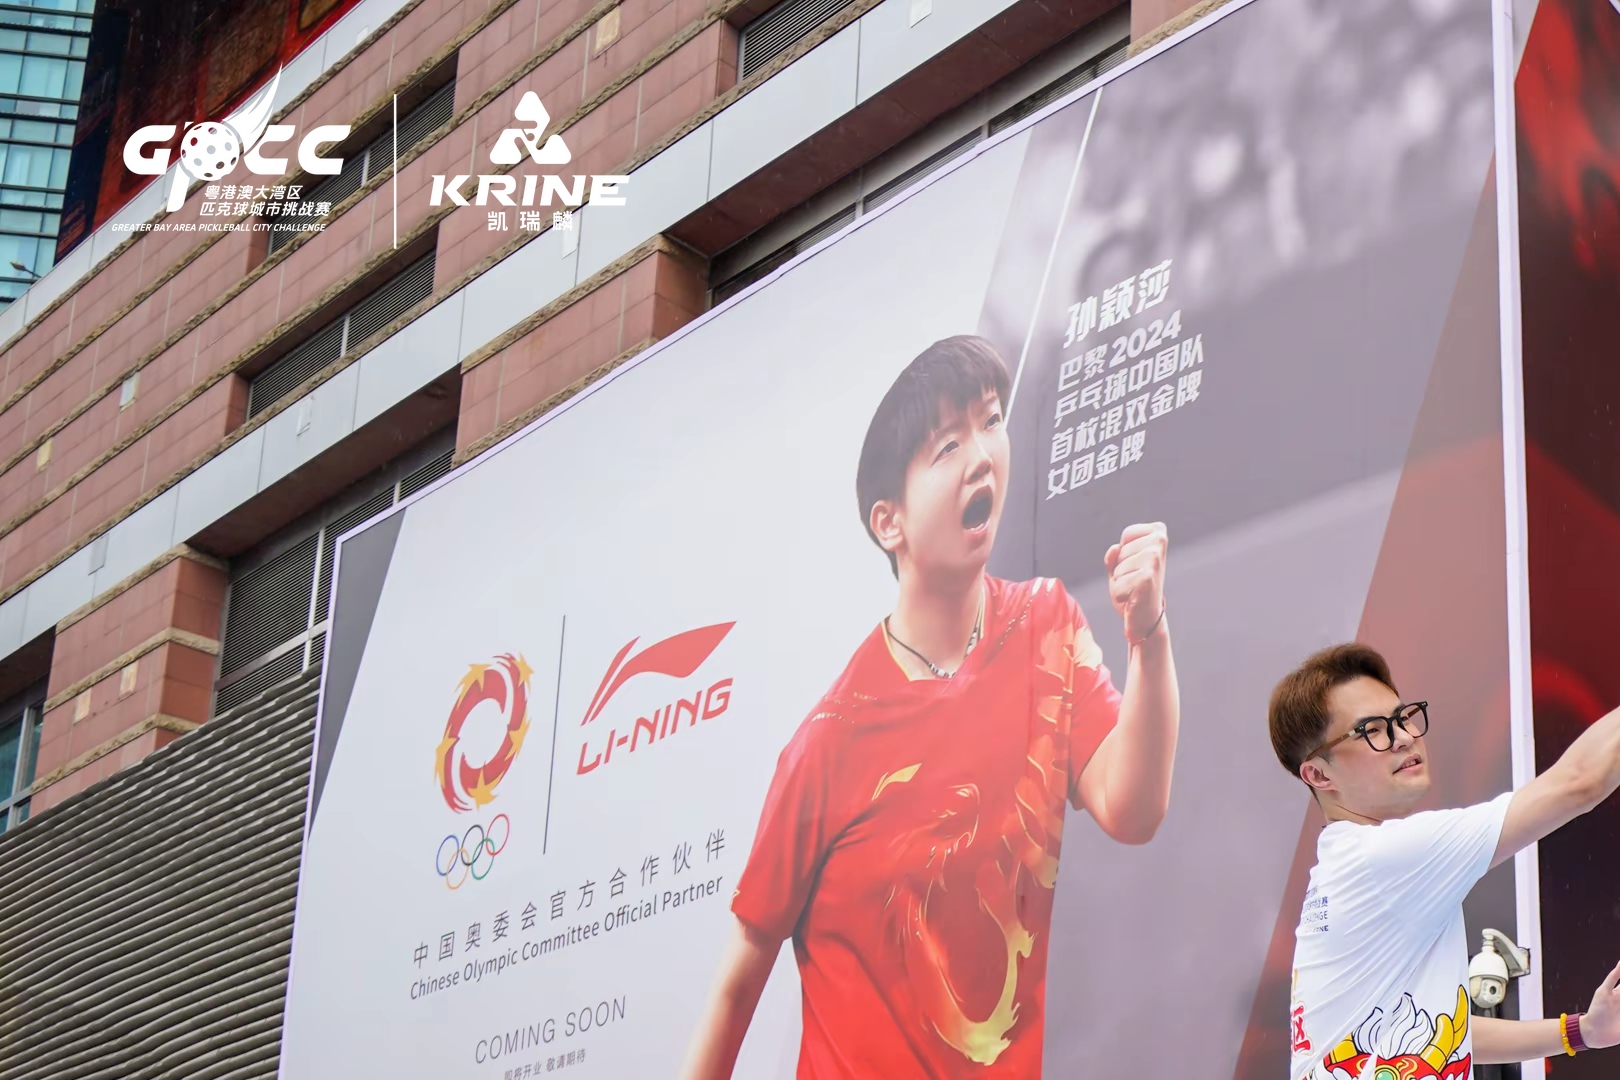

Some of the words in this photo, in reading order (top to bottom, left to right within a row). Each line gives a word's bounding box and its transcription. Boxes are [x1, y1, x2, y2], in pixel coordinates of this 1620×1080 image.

[1063, 259, 1173, 349] 孙颖莎
[1050, 369, 1203, 464] 首枚混双金牌
[1054, 333, 1204, 428] 乒乓球中国队
[1045, 430, 1146, 500] 女团金牌
[577, 677, 733, 776] LI-NING
[410, 968, 460, 1000] Chinese
[463, 947, 518, 984] Olympic
[521, 919, 600, 962] Committee
[604, 893, 658, 933] Official
[662, 874, 724, 912] Partner
[413, 827, 726, 969] 中国奥委会官方合作伙伴
[475, 1018, 556, 1064] COMING
[565, 995, 626, 1037] SOON
